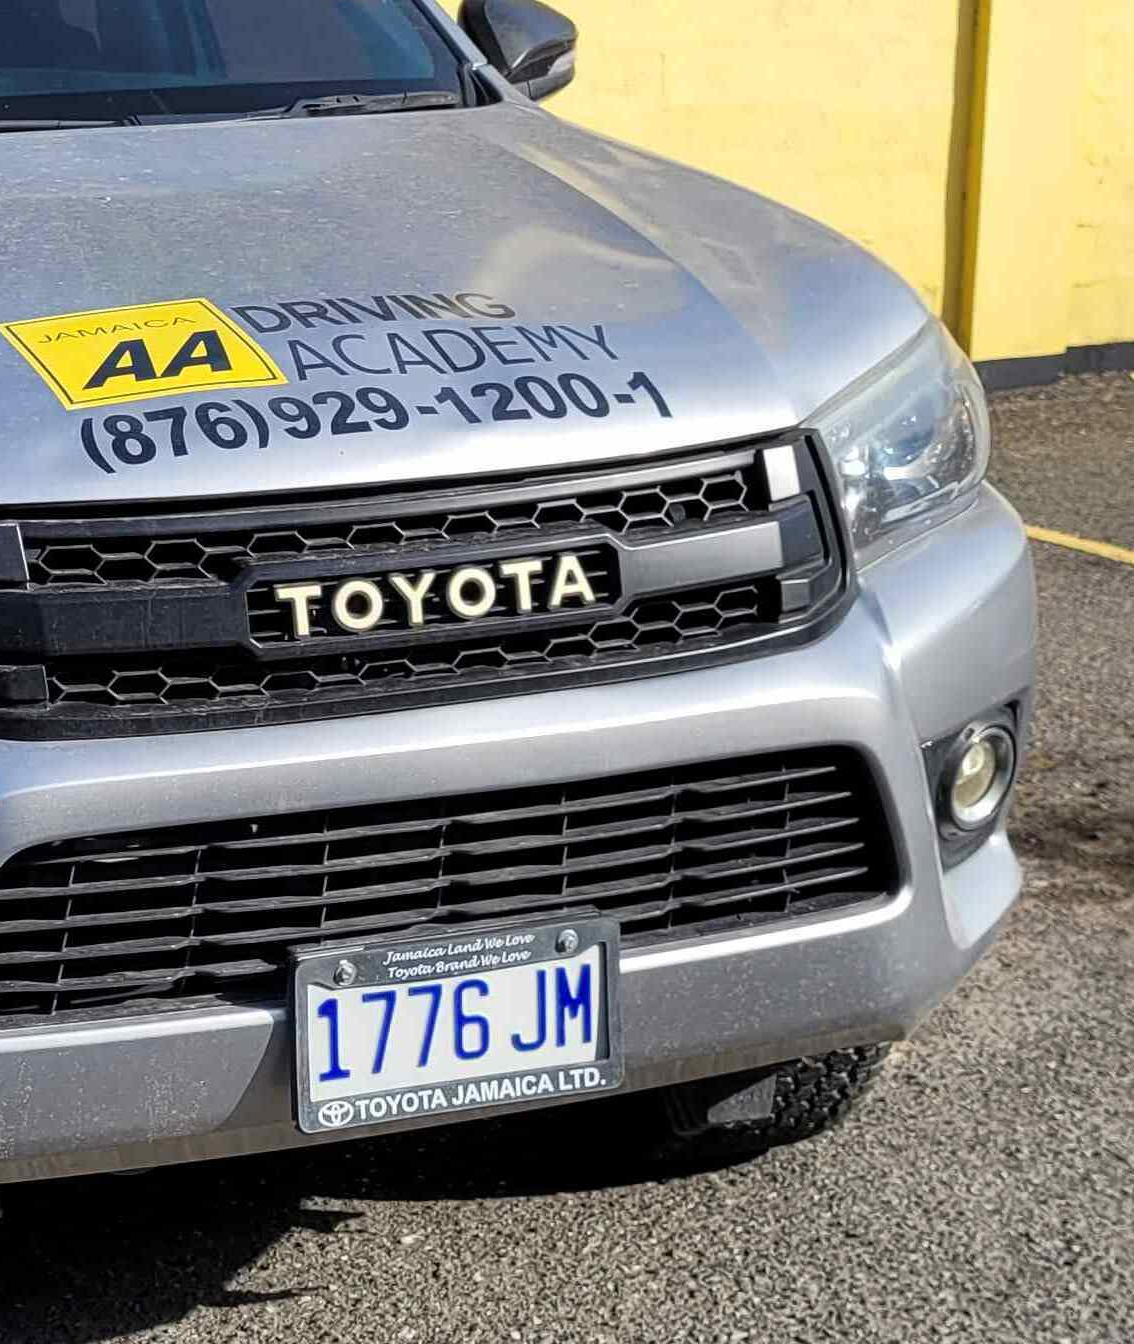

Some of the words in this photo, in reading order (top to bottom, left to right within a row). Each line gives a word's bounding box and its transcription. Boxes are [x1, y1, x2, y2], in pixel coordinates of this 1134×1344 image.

[38, 316, 197, 344] JAMAICA
[233, 292, 516, 335] DRIVING
[83, 329, 232, 390] AA
[287, 324, 619, 381] ACADEMY
[79, 370, 673, 474] (876)929-1200-1
[275, 552, 596, 640] TOYOTA
[383, 947, 447, 965] Jamaica
[448, 938, 484, 956] Land
[484, 937, 505, 949] We
[506, 934, 535, 947] Love
[388, 964, 436, 980] Toyota
[436, 955, 480, 973] Brand
[480, 953, 501, 966] We
[502, 950, 531, 964] Love
[317, 979, 490, 1083] 1776
[511, 963, 592, 1053] JM
[356, 1089, 447, 1121] TOYOTA
[452, 1074, 554, 1106] JAMAICA
[558, 1067, 606, 1092] LTD.
